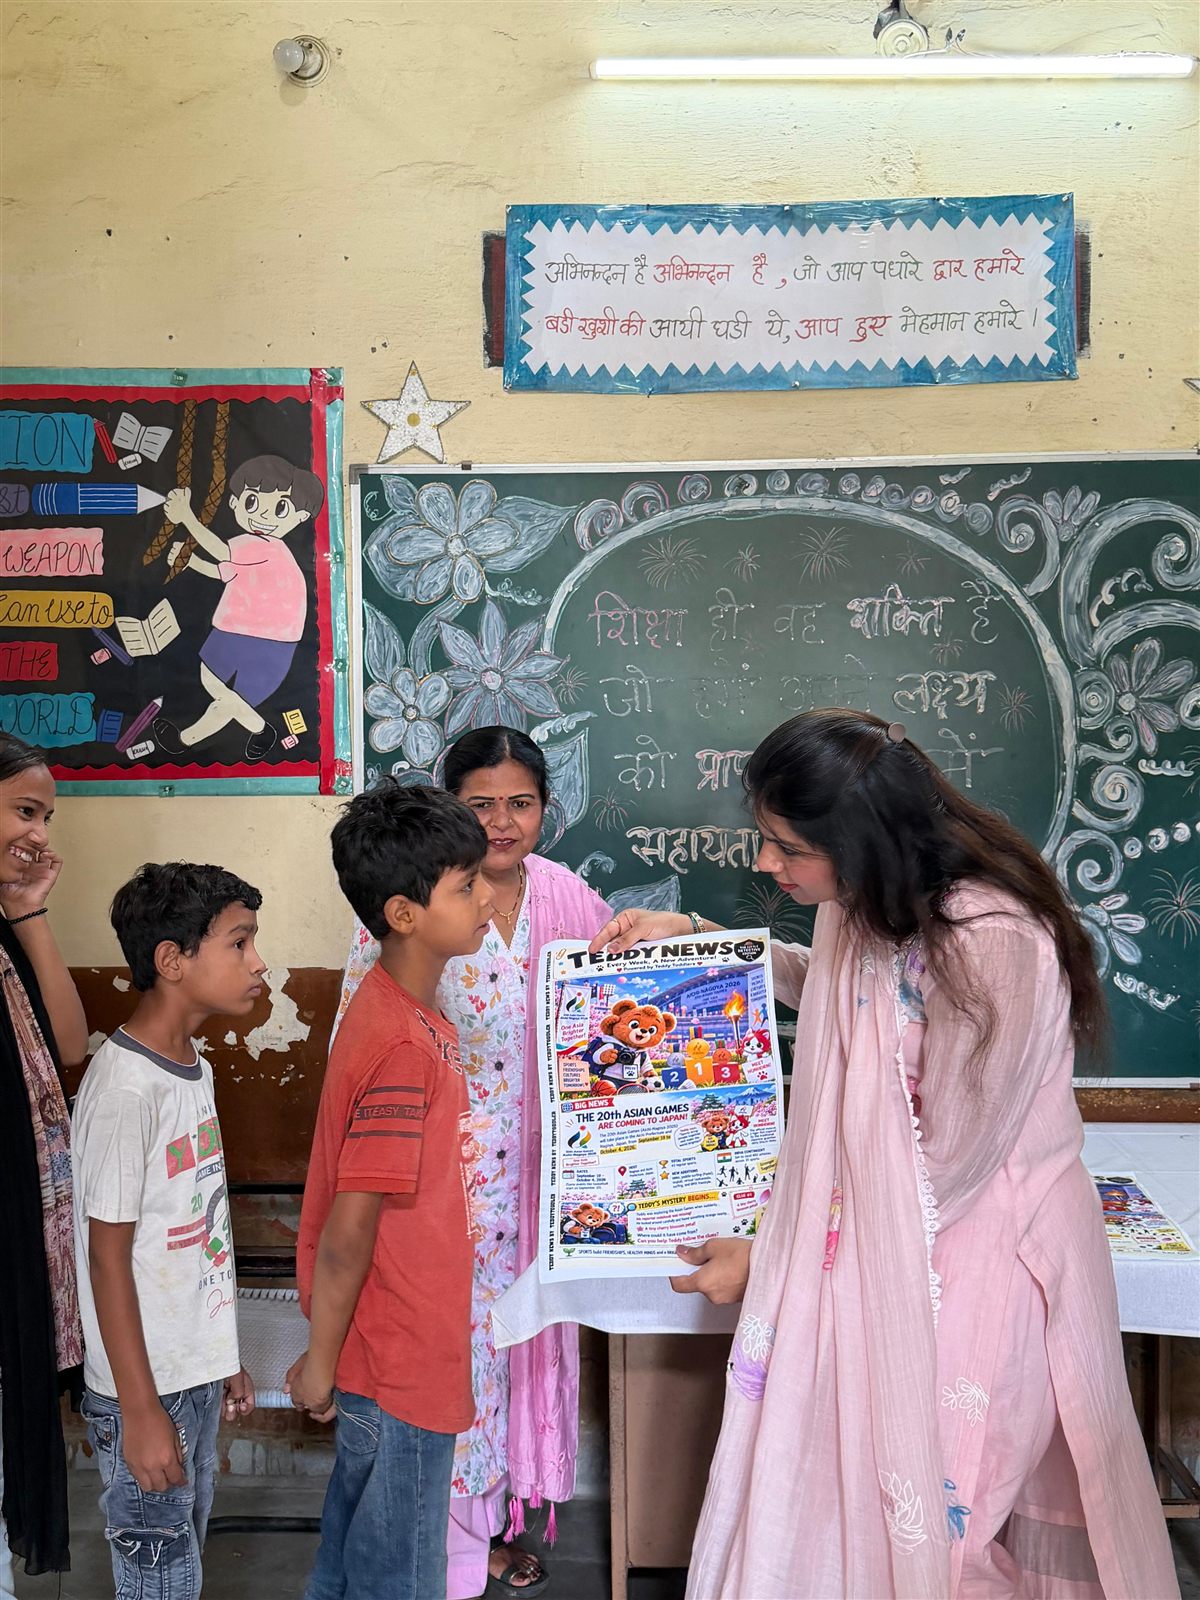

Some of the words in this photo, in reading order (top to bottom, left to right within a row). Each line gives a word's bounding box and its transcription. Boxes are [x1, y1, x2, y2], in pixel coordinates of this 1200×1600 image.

[545, 252, 626, 284] अभिनन्दन
[634, 253, 647, 285] है
[653, 256, 733, 284] अभिनन्दन
[792, 255, 818, 282] जो
[826, 258, 862, 283] आप
[870, 250, 923, 282] पधारे
[974, 248, 1025, 280] हमारे
[650, 306, 707, 339] आयी
[795, 315, 843, 339] आप
[900, 305, 970, 334] मेहमान
[974, 299, 1025, 334] हमारे
[0, 415, 88, 468] ION
[3, 541, 101, 573] WEAPON
[587, 590, 688, 648] शिक्षा
[1, 647, 51, 678] THE
[625, 825, 761, 874] सहायता
[567, 946, 658, 969] TEDDY
[662, 941, 734, 958] NEWS
[670, 1071, 680, 1082] 2
[694, 1062, 703, 1076] 1
[721, 1067, 731, 1079] 3
[574, 1101, 587, 1109] BIG
[588, 1099, 609, 1108] NEWS
[576, 1112, 595, 1123] THE
[597, 1109, 621, 1121] 20th
[623, 1107, 653, 1119] ASIAN
[655, 1103, 690, 1116] GAMES
[598, 1121, 613, 1130] ARE
[615, 1118, 645, 1128] COMING
[647, 1116, 657, 1124] TO
[659, 1113, 688, 1124] JAPAN!
[638, 1200, 661, 1209] TEDDY'S
[662, 1196, 686, 1206] MYSTERY
